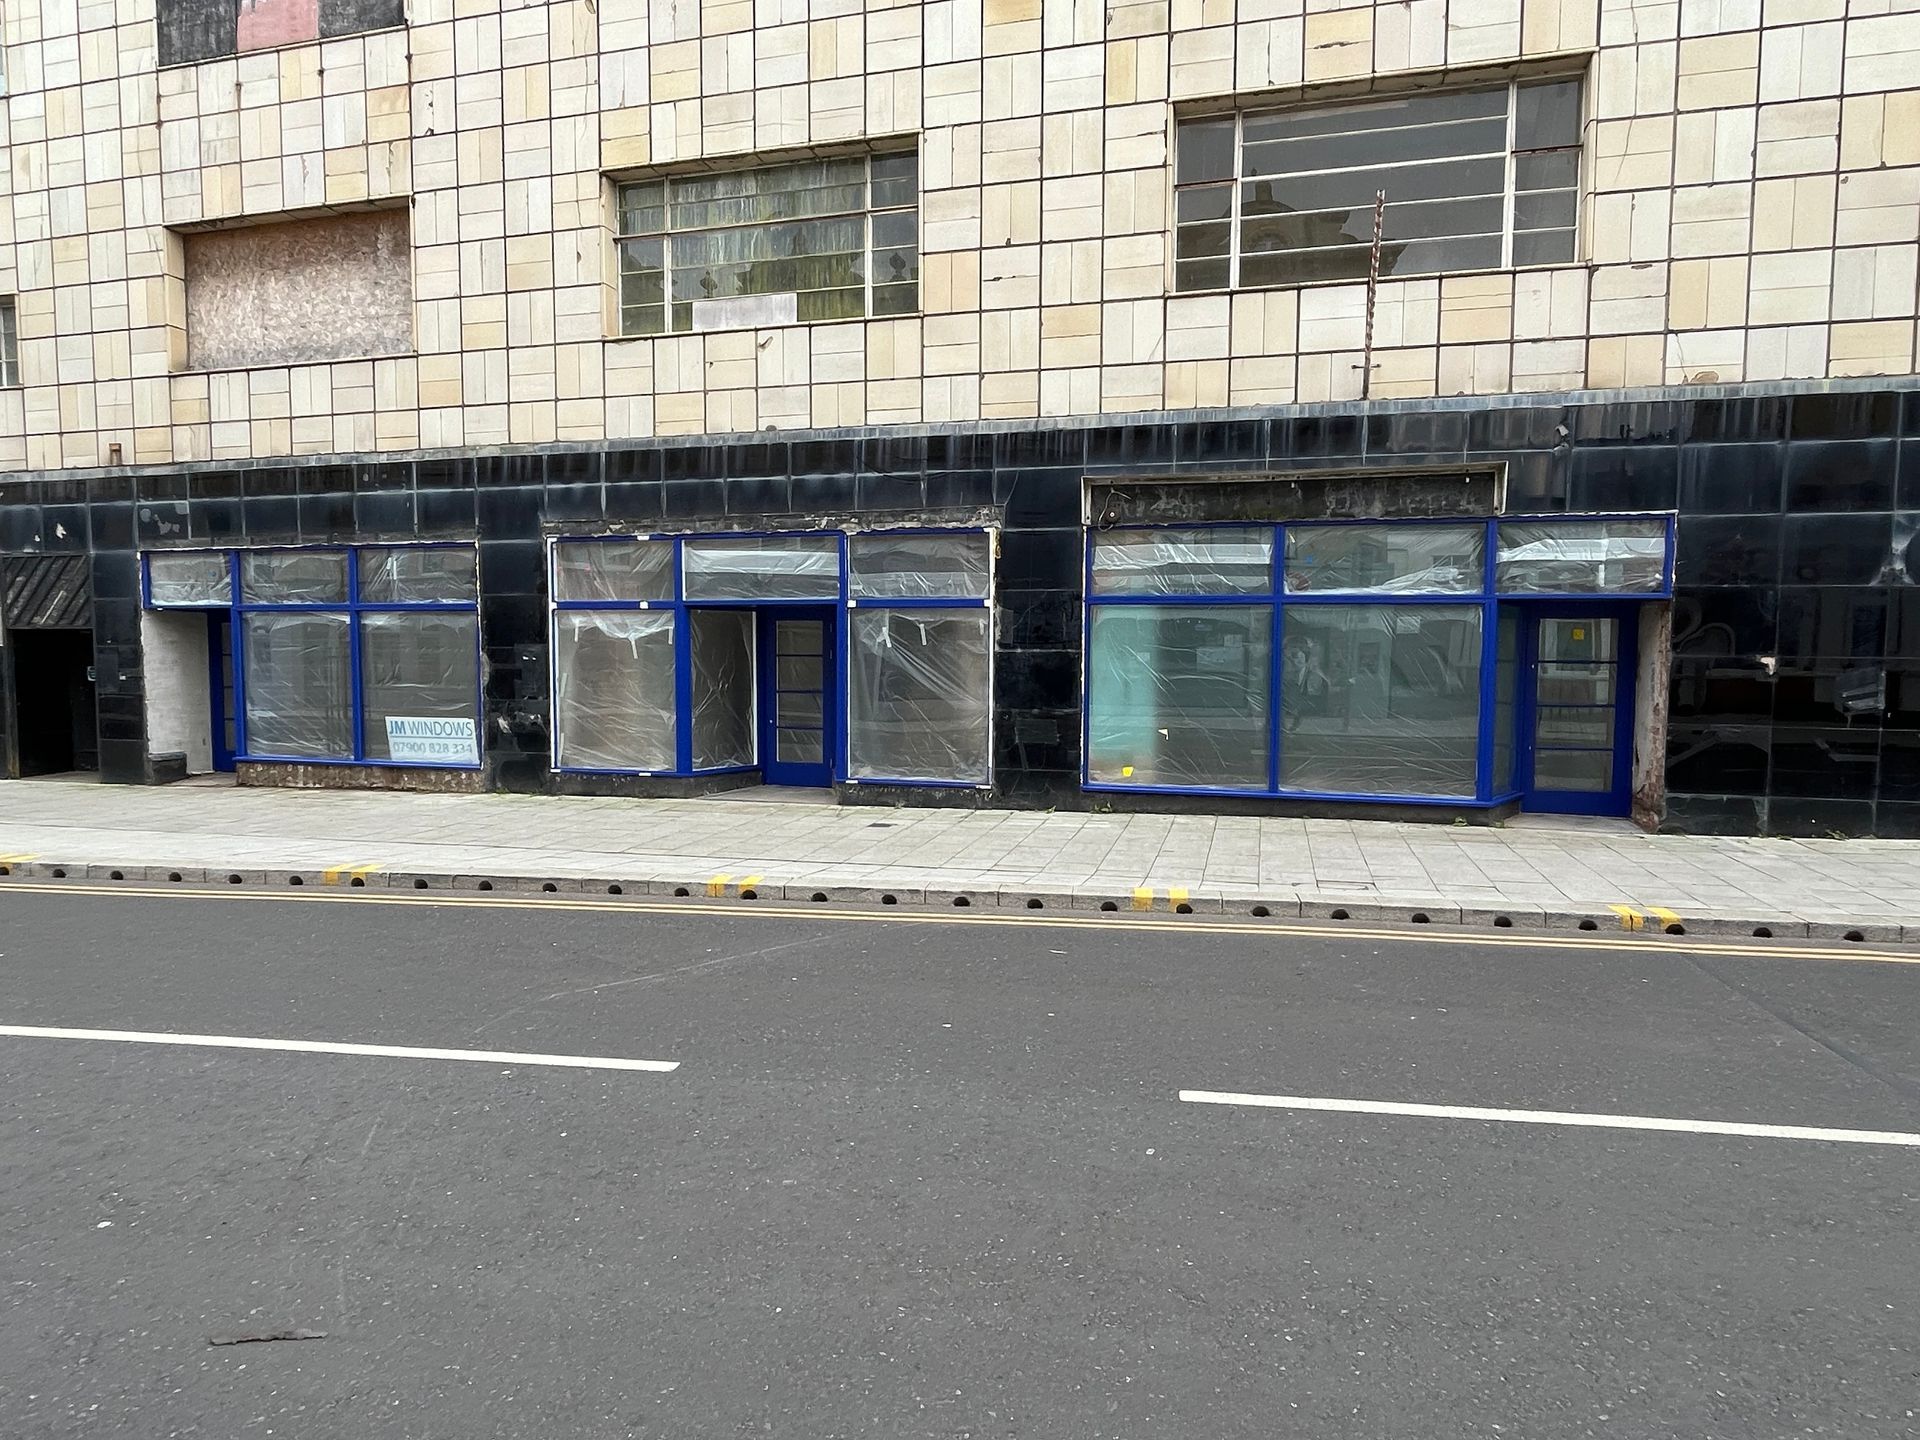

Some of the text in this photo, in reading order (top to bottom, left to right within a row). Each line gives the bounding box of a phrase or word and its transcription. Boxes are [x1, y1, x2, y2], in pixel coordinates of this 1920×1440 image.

[389, 720, 473, 737] JM WINDOWS
[392, 741, 427, 754] 07900
[428, 742, 449, 754] 828
